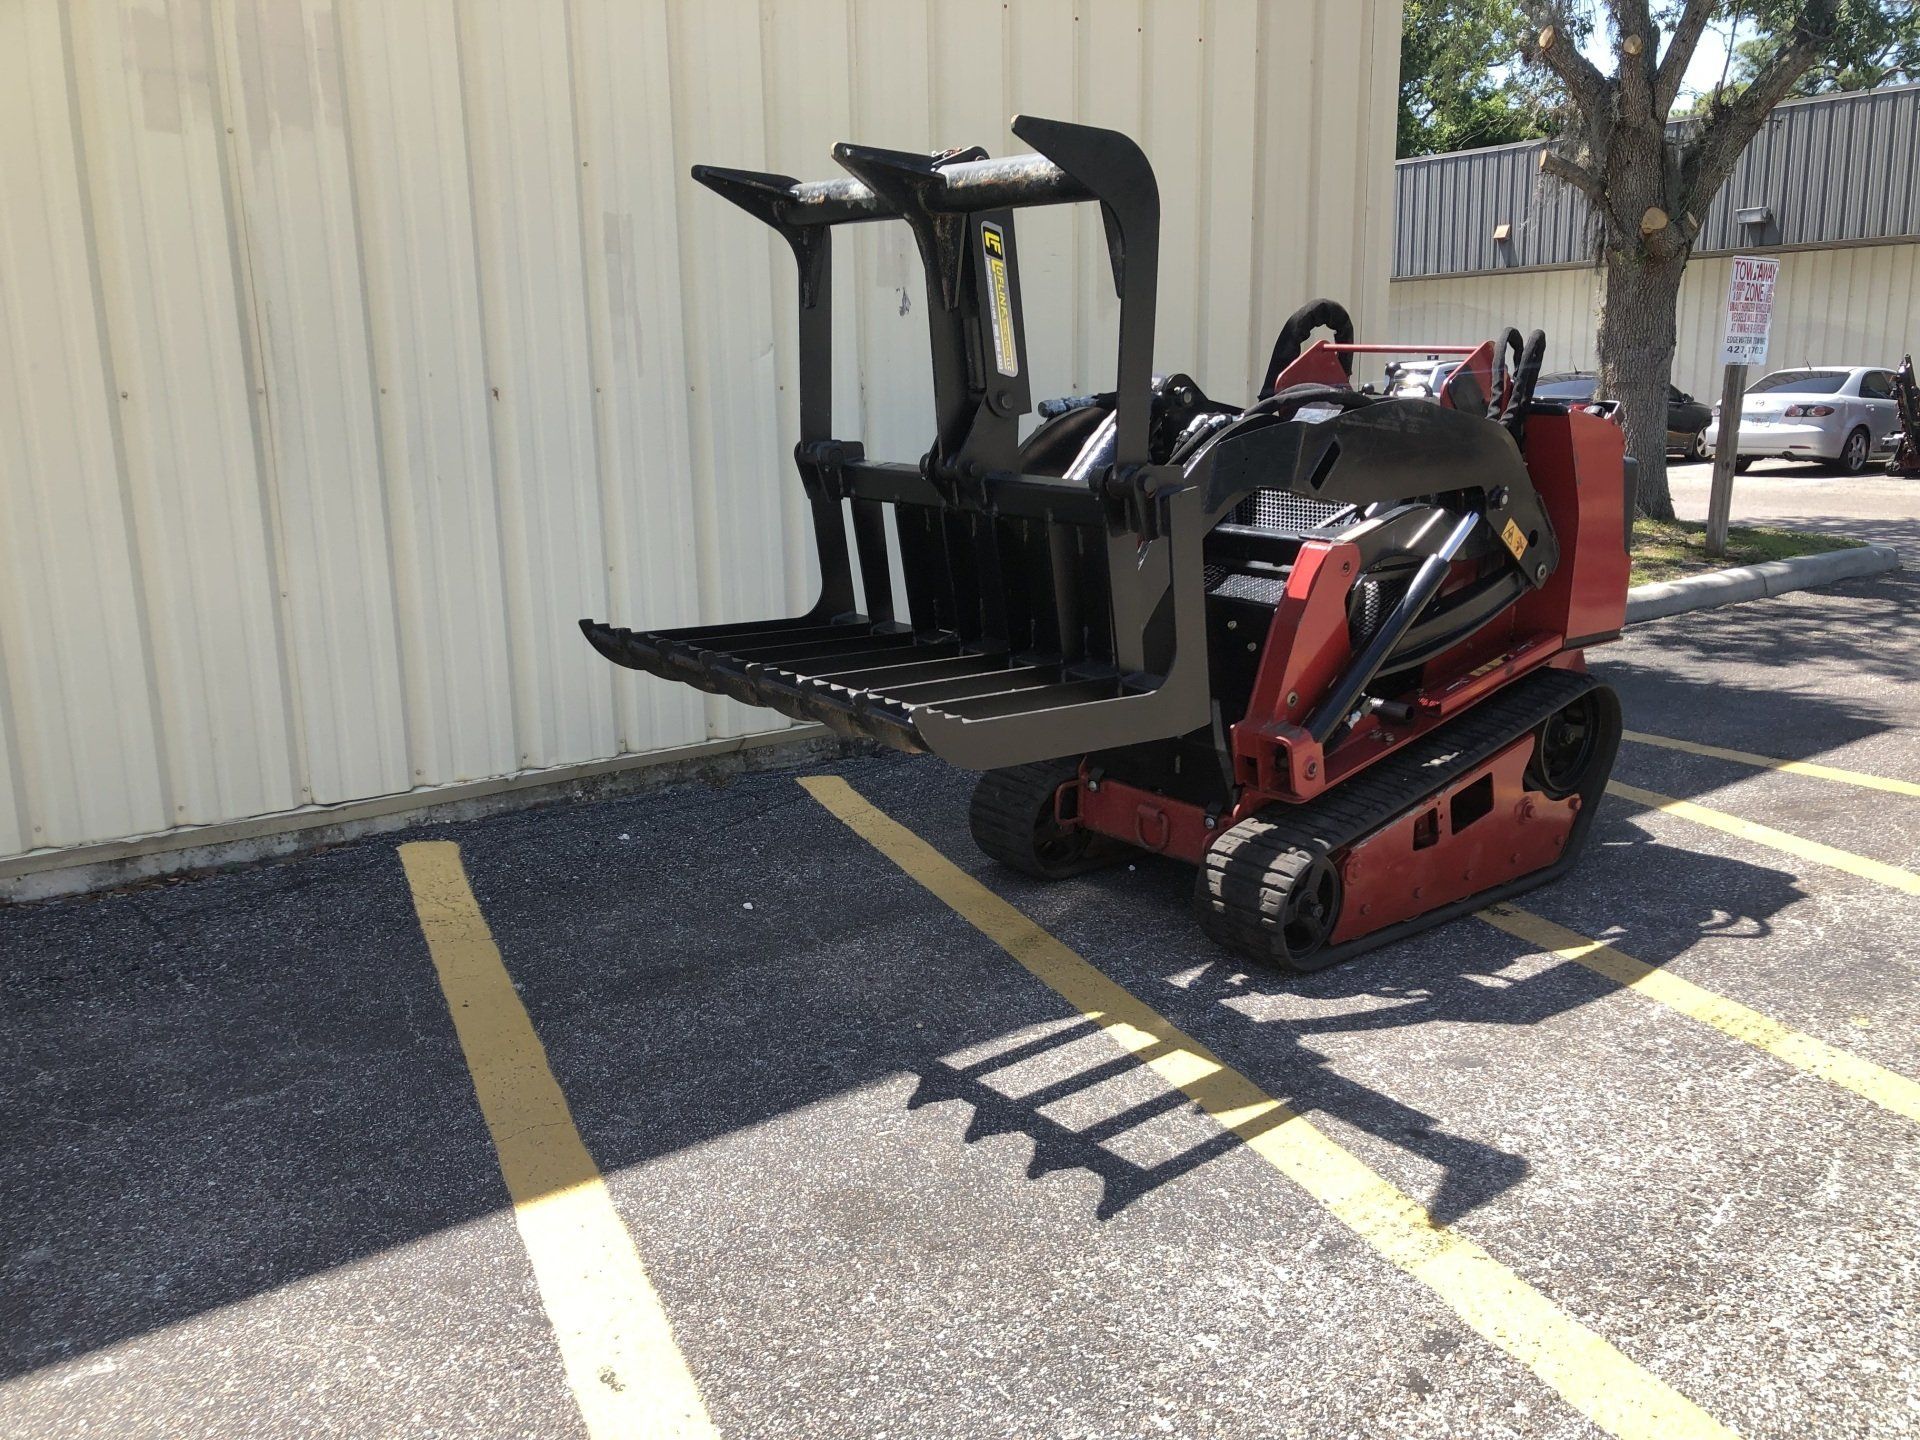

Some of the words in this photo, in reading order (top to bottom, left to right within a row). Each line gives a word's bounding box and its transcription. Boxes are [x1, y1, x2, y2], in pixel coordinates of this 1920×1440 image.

[984, 231, 1002, 256] LF
[1744, 283, 1764, 302] ZONE
[1726, 336, 1752, 344] EDGEWATER
